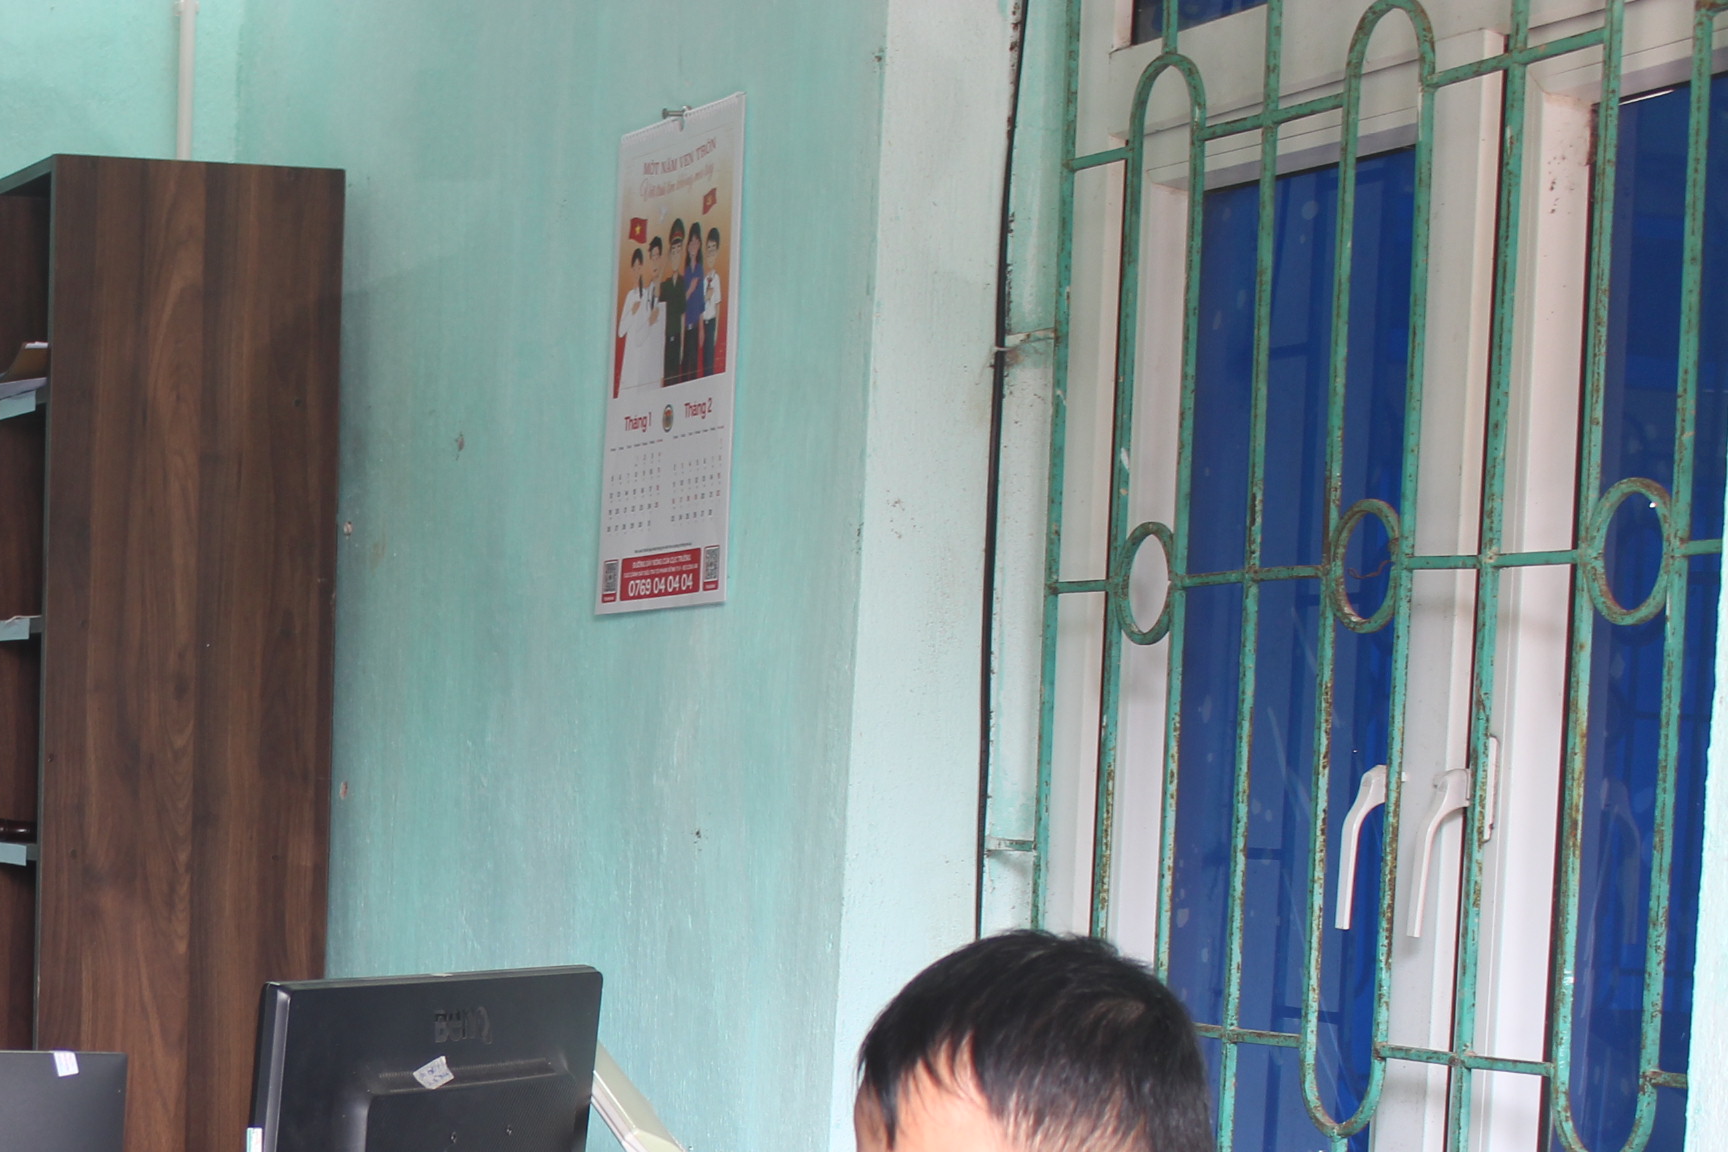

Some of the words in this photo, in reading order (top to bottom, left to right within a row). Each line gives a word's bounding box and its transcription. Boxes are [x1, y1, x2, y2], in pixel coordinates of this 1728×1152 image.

[684, 400, 707, 420] Tháng
[708, 397, 713, 413] 2
[624, 414, 648, 433] Tháng
[628, 578, 652, 597] 0769
[653, 577, 666, 594] 04
[667, 575, 680, 592] 04
[681, 573, 693, 591] 04
[433, 1006, 493, 1045] BenQ
